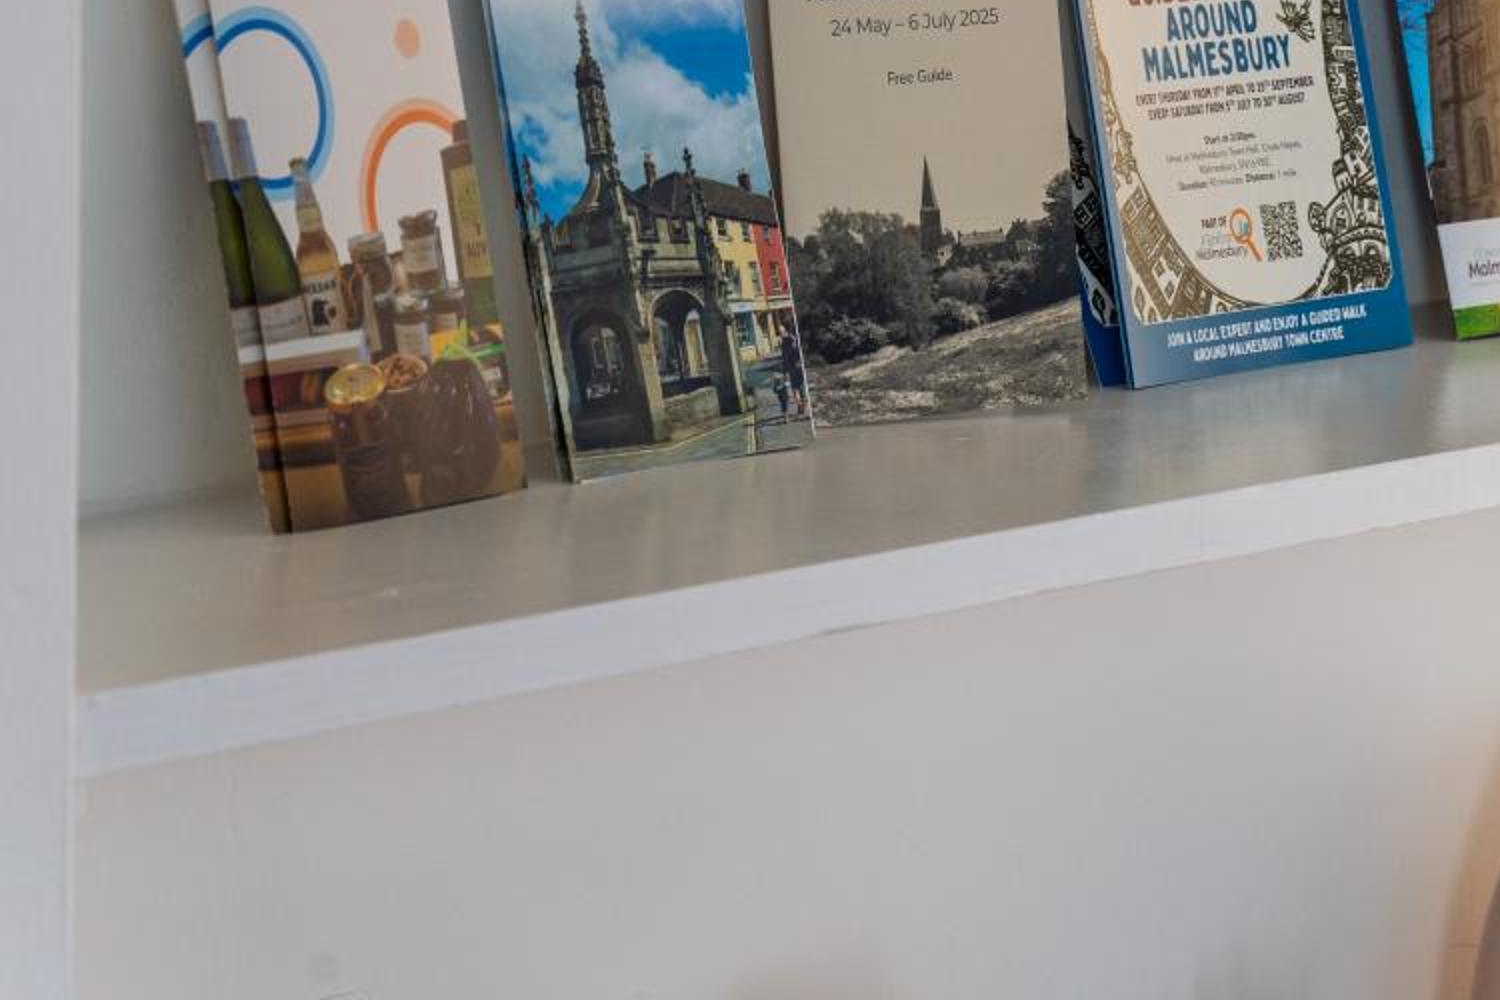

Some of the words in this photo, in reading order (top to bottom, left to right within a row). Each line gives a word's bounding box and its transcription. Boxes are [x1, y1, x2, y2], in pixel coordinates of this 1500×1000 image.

[831, 18, 852, 37] 24
[856, 14, 892, 37] May
[908, 12, 919, 31] 6
[920, 10, 957, 33] July
[960, 7, 1000, 27] 2025
[1167, 0, 1258, 42] AROUND
[887, 70, 914, 86] Free
[917, 67, 953, 84] Guide
[1141, 34, 1291, 83] MALMESBURY
[1271, 75, 1314, 91] SEPTEMBER
[1168, 332, 1185, 347] JOIN
[1193, 327, 1219, 343] LOCAL
[1220, 323, 1251, 340] EXPERT
[1253, 319, 1272, 334] AND
[1273, 315, 1299, 330] ENJOY
[1301, 313, 1308, 327] A
[1309, 308, 1342, 325] GUIDED
[1342, 303, 1367, 319] WALK
[1194, 345, 1228, 362] AROUND
[1229, 338, 1284, 357] MALMESBURY
[1285, 332, 1309, 348] TOWN
[1310, 326, 1345, 344] CENTRE
